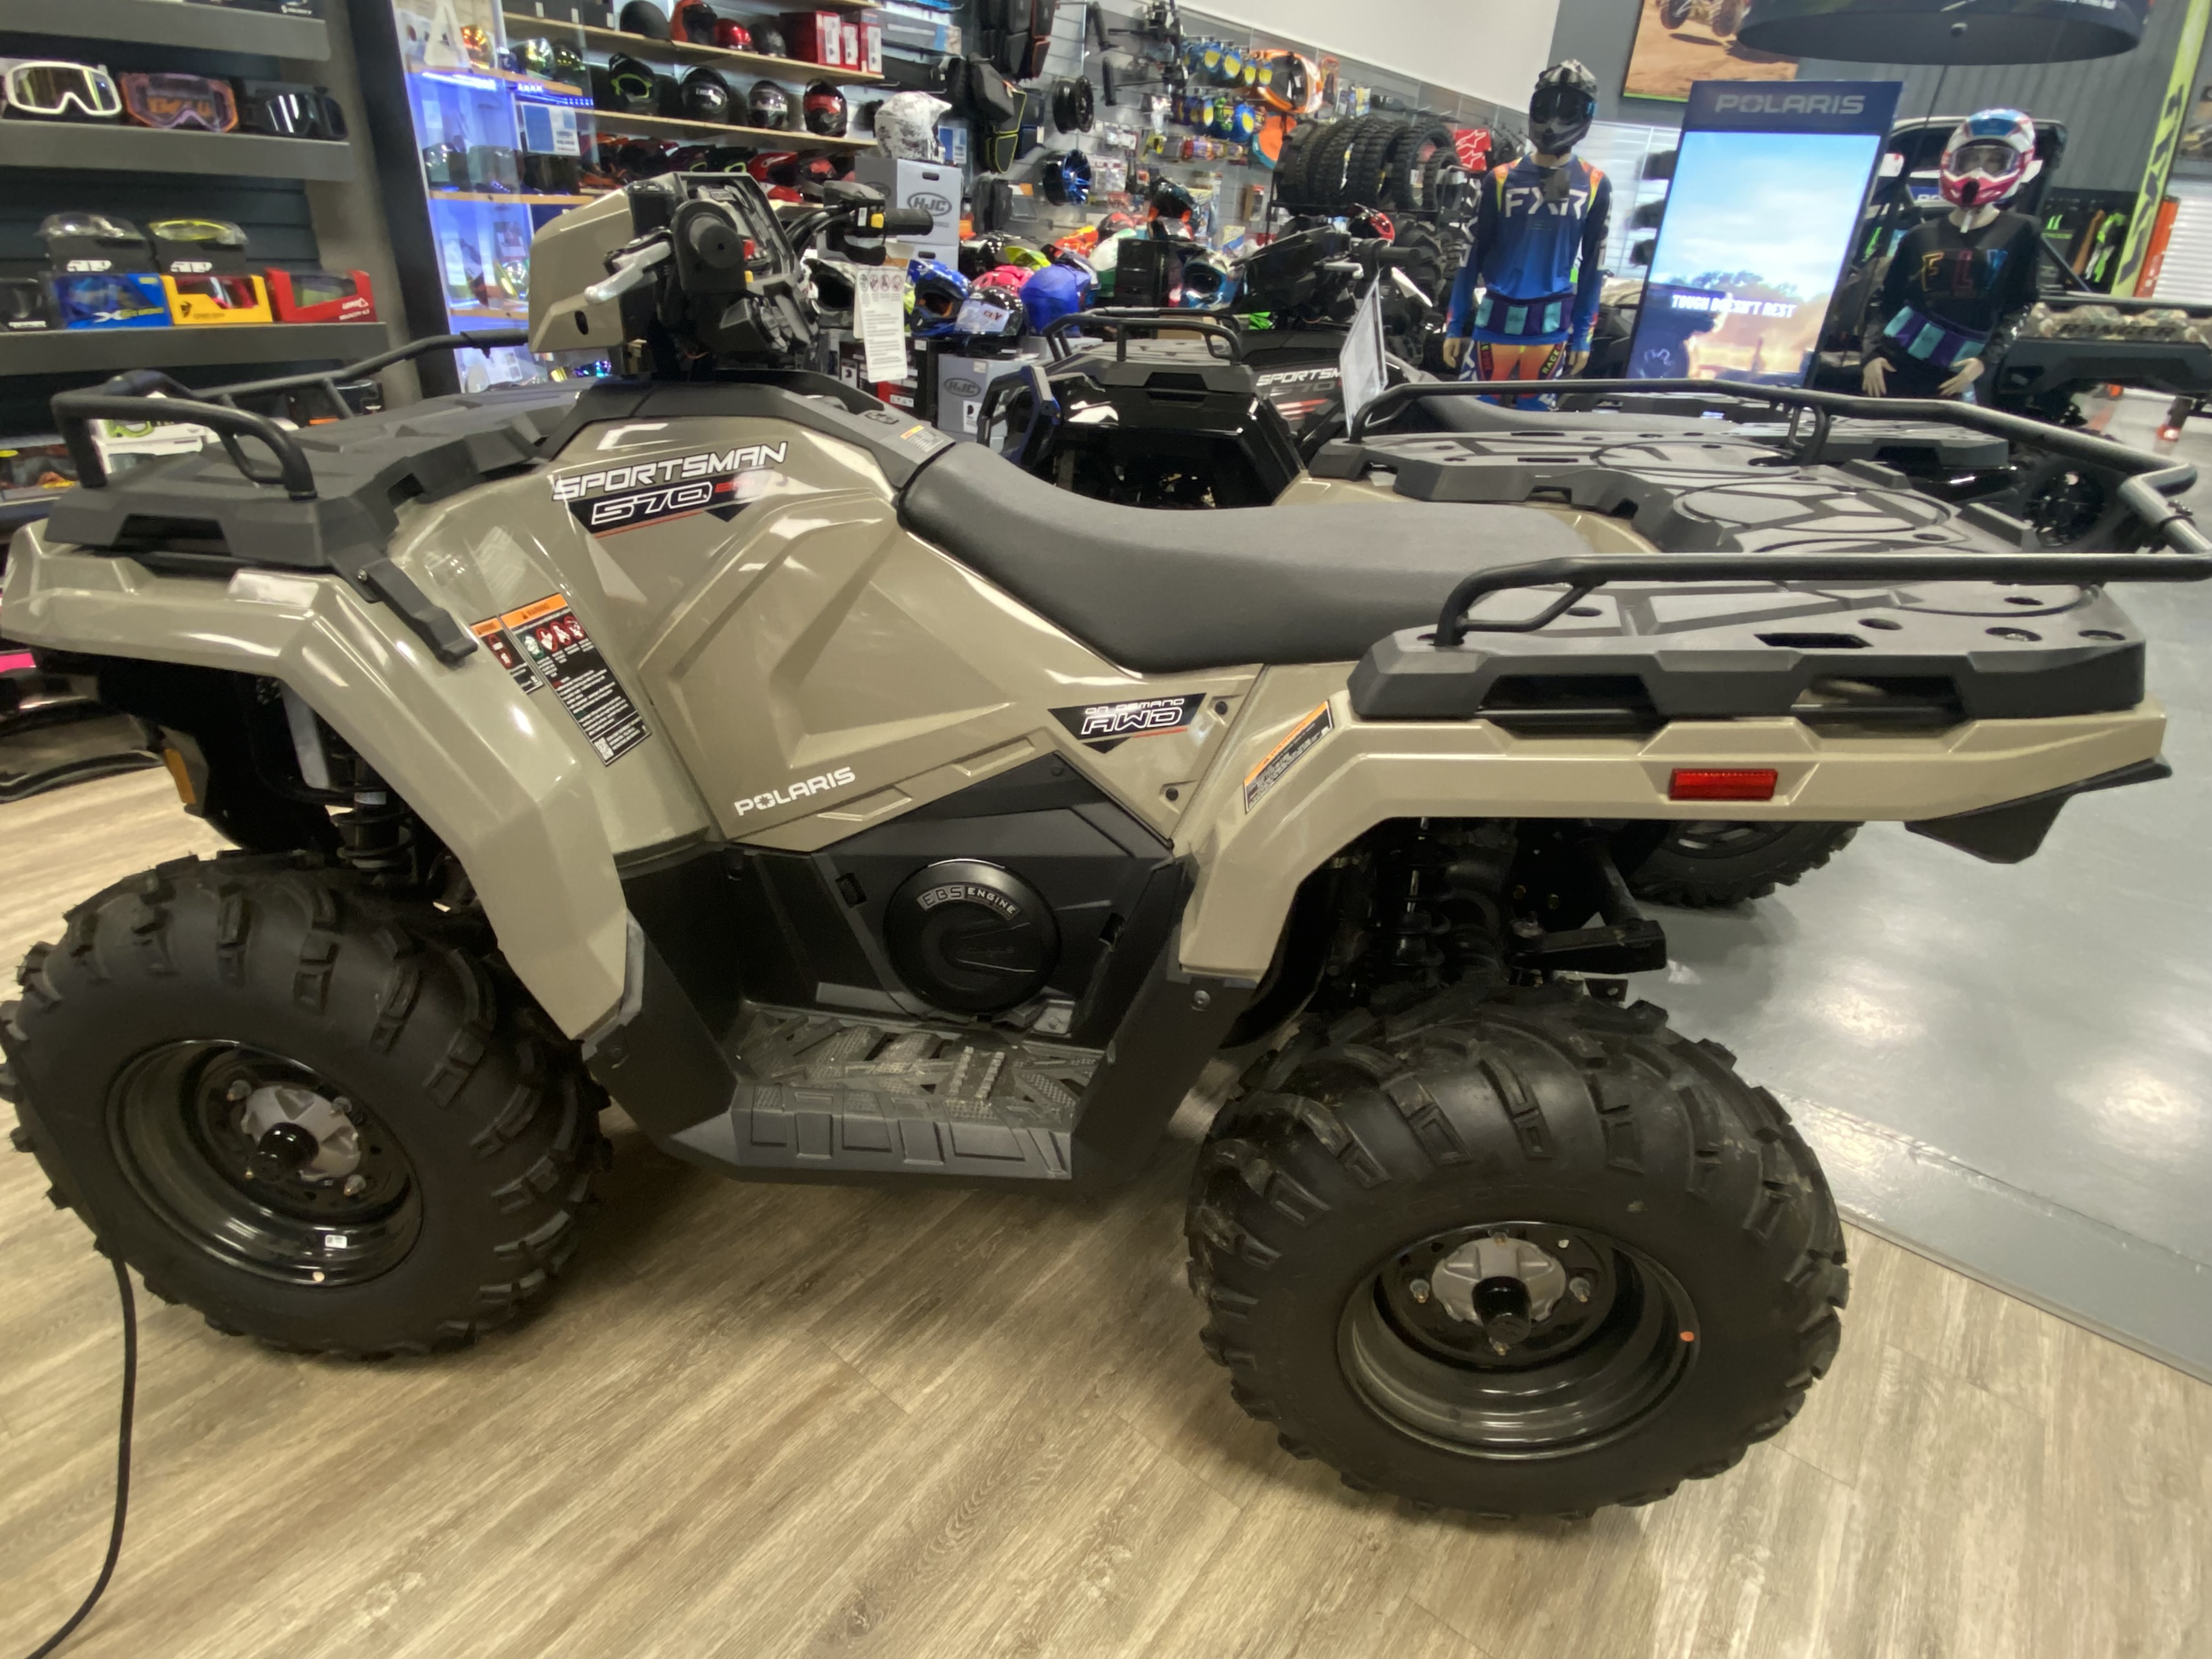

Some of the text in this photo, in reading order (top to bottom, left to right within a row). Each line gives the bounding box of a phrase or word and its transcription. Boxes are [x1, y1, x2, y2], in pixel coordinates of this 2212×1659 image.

[1715, 94, 1866, 114] POLARIS
[913, 196, 946, 211] HJC
[1672, 294, 1711, 311] TOUGH
[1762, 302, 1797, 318] REST
[1256, 368, 1341, 386] SPORTSM
[551, 441, 788, 501] SPORTSMAN
[591, 481, 713, 526] 570
[1081, 707, 1183, 735] AWD
[733, 766, 856, 816] POLARIS
[922, 886, 1016, 914] EBS ENGINE
